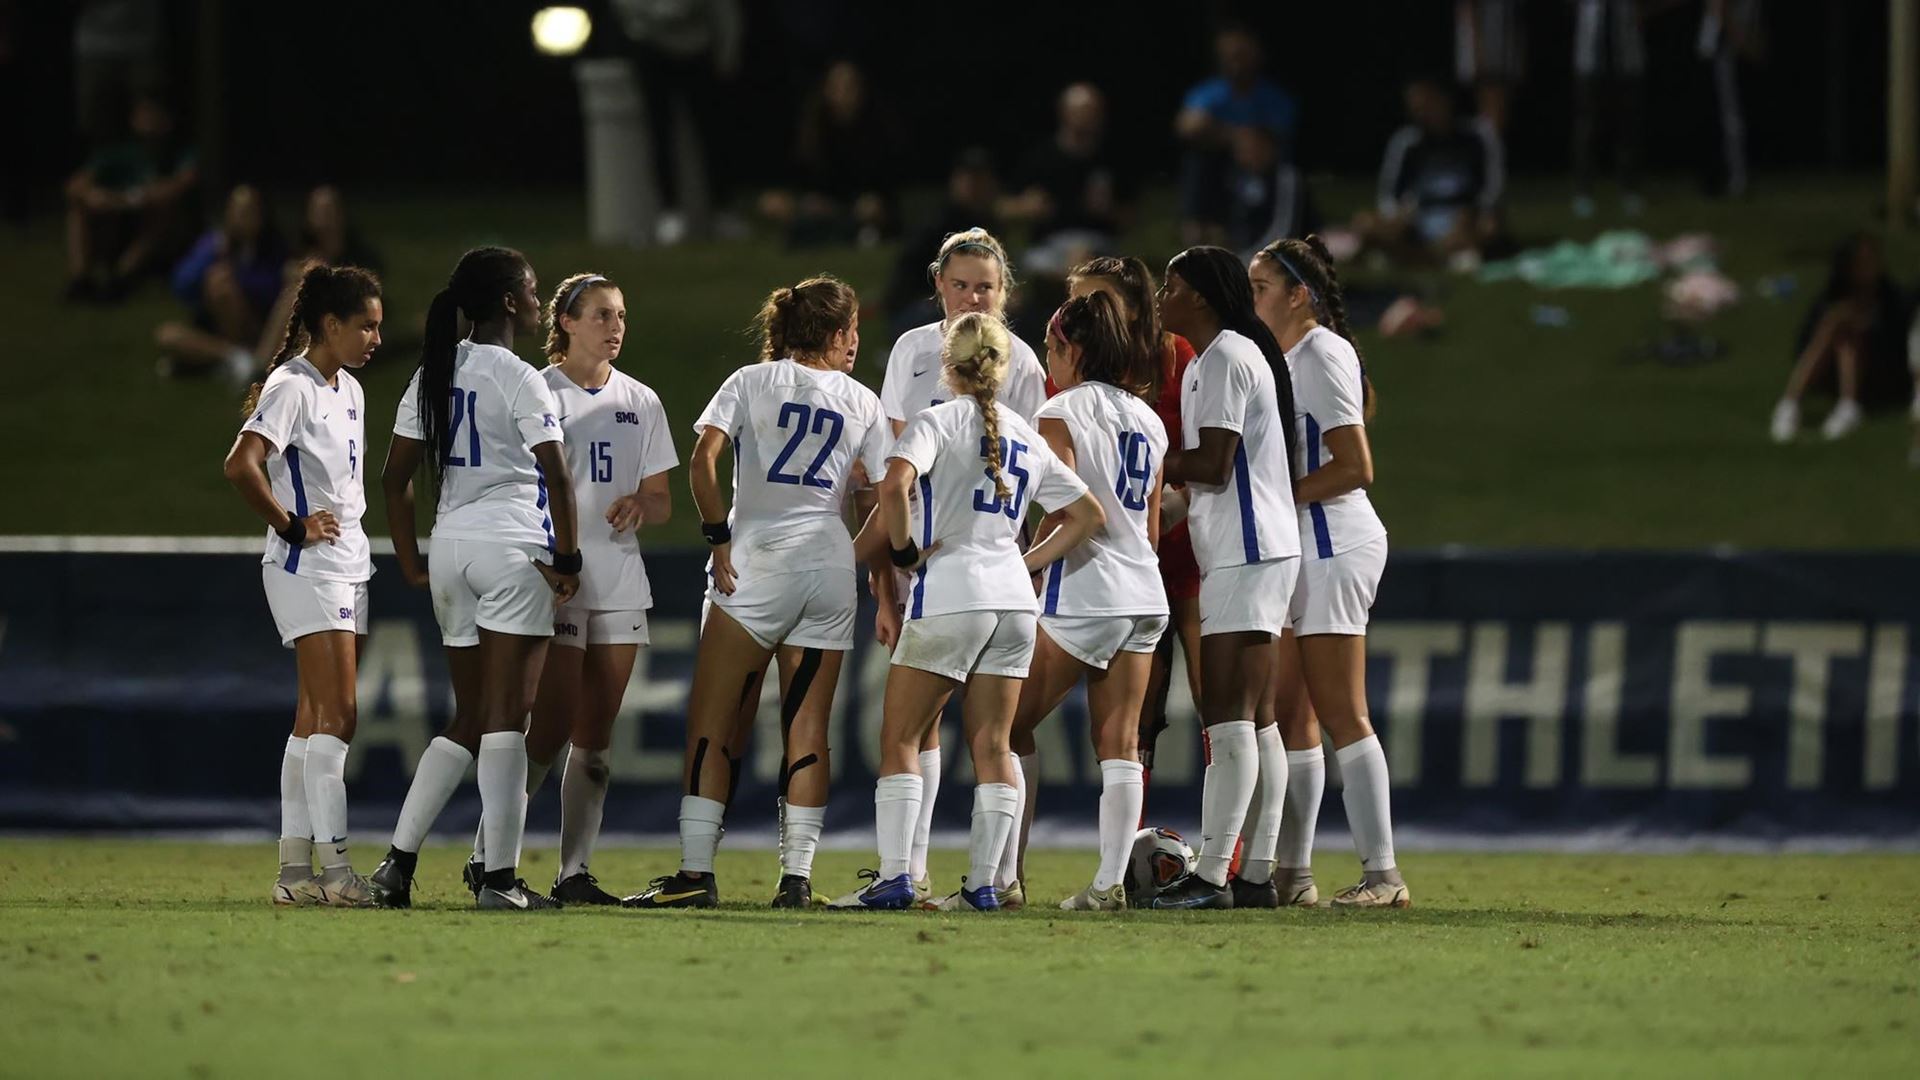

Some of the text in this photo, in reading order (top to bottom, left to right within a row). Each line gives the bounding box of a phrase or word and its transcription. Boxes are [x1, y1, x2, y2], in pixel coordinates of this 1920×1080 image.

[447, 387, 482, 467] 21
[615, 412, 639, 425] SMU
[767, 402, 844, 489] 22
[590, 441, 612, 482] 15
[973, 436, 1029, 520] 35
[1115, 431, 1151, 511] 19
[1345, 619, 1918, 789] THLETI
